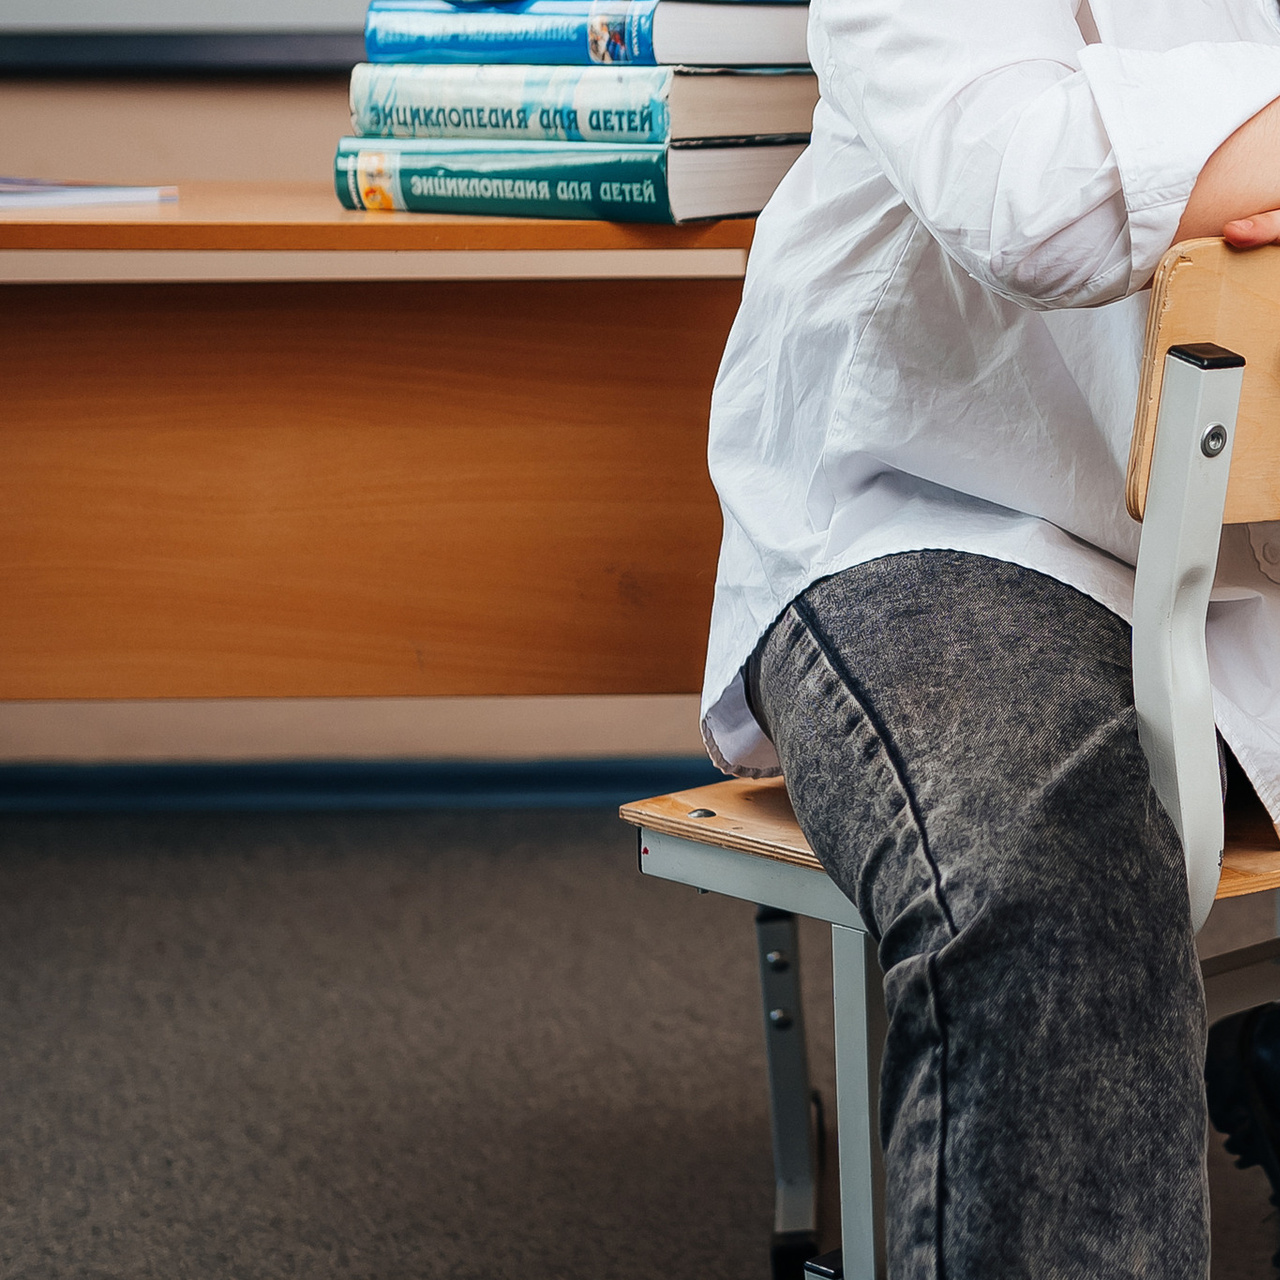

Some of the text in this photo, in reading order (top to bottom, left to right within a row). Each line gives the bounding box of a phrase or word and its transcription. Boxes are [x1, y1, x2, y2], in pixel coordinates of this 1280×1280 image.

[369, 103, 655, 133] ЭНЦИКЛОПЕДИЯ ДЛЯ ДЕТЕЙ
[410, 174, 657, 204] ЭНЦИКЛОПЕДИЯ ДЛЯ ДЕТЕЙ
